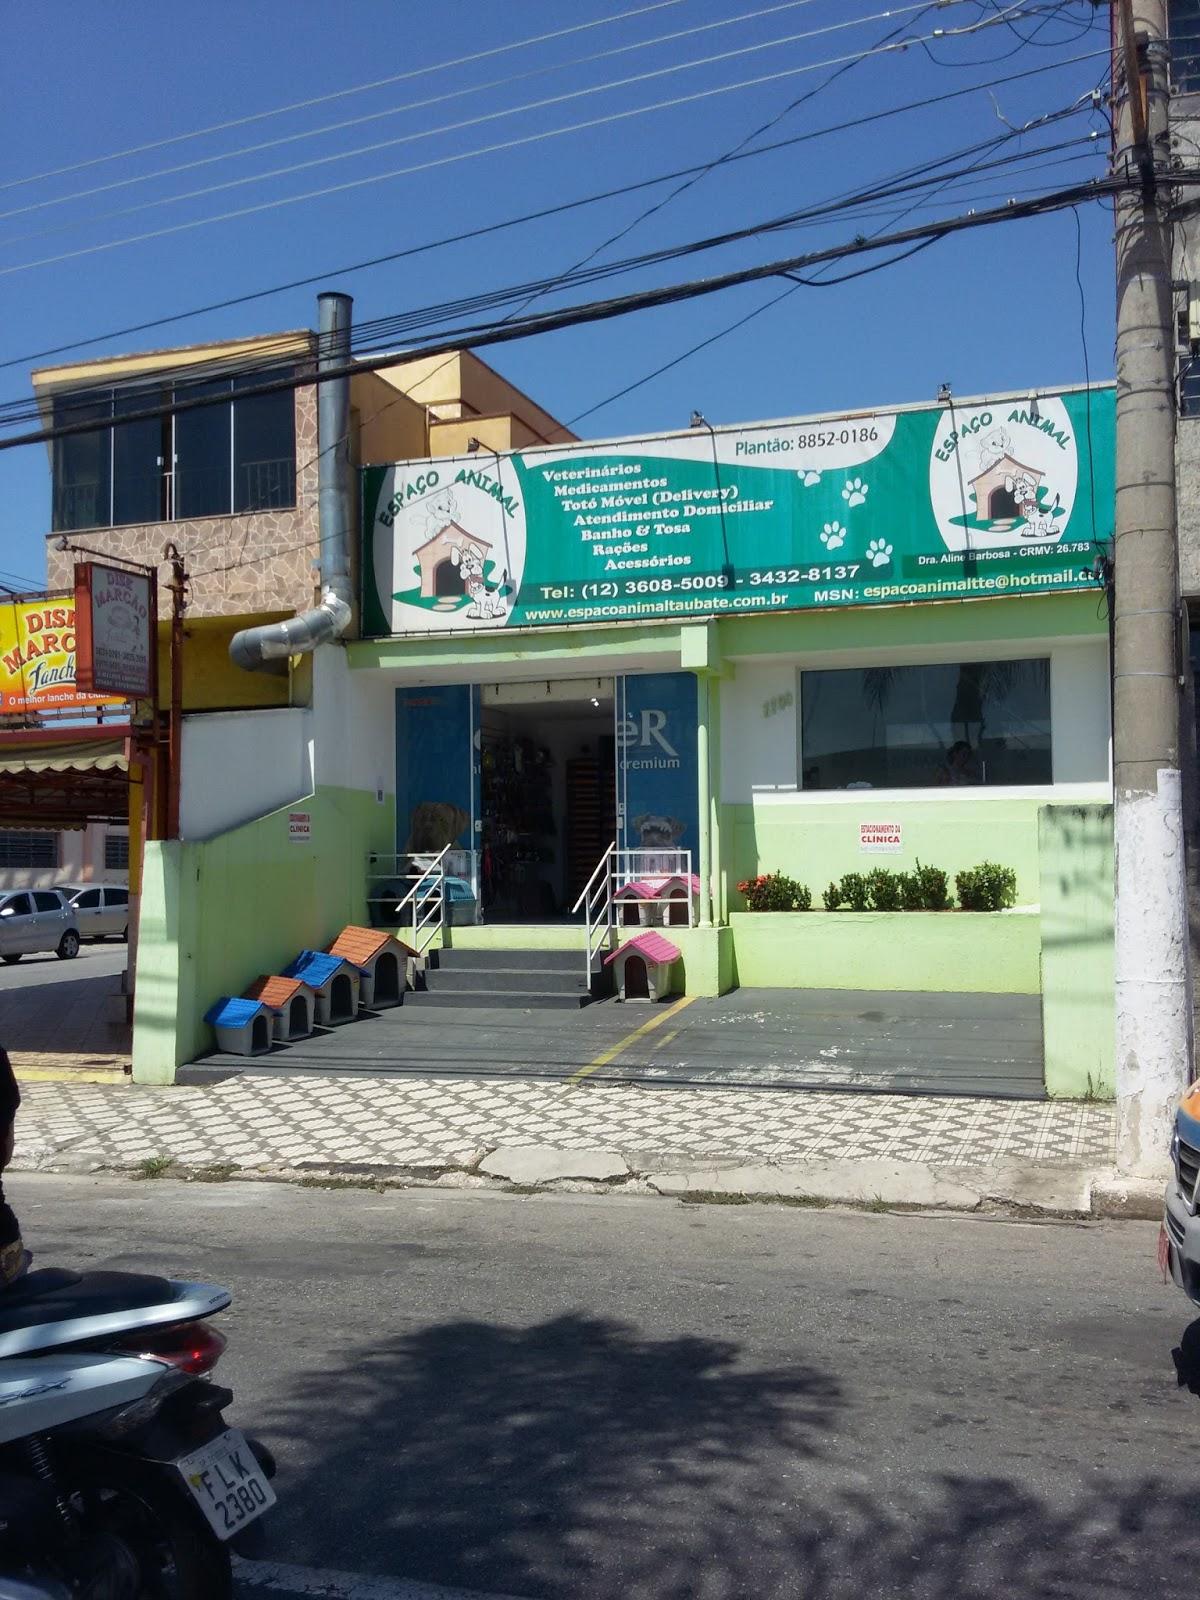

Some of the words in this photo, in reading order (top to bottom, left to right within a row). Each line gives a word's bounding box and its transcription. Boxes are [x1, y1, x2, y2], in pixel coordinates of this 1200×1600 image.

[735, 437, 794, 456] Plantão:
[798, 427, 879, 449] 8852-0186
[934, 412, 993, 462] ESPAÇO
[1007, 409, 1071, 450] ANIMAL
[543, 464, 641, 482] Veterinários
[378, 470, 439, 527] ESPAÇO
[454, 468, 519, 518] ANIMAL
[554, 477, 668, 497] Medicamentos
[561, 498, 597, 511] Totó
[601, 493, 648, 509] Móvel
[652, 485, 739, 505] (Delivery)
[573, 508, 679, 526] Atendimento
[683, 500, 774, 517] Domiciliar
[581, 528, 632, 541] Banho
[636, 525, 650, 536] &
[653, 523, 691, 535] Tosa
[593, 542, 648, 556] Rações
[604, 554, 692, 570] Acessórios
[918, 556, 938, 565] Dra.
[941, 553, 965, 563] Aline
[968, 550, 1010, 561] Barbosa
[1019, 545, 1053, 557] CRMV:
[1056, 543, 1090, 554] 26.783
[540, 586, 574, 600] Tel:
[582, 583, 619, 600] (12)
[625, 575, 729, 594] 3608-5009
[750, 565, 860, 585] 3432-8137
[814, 589, 859, 602] MSN:
[525, 592, 788, 620] www.espacoanimaltaubate.com.br
[9, 697, 16, 706] O
[18, 694, 45, 705] melhor
[200, 1450, 250, 1501] FLK
[214, 1478, 267, 1531] 2380
